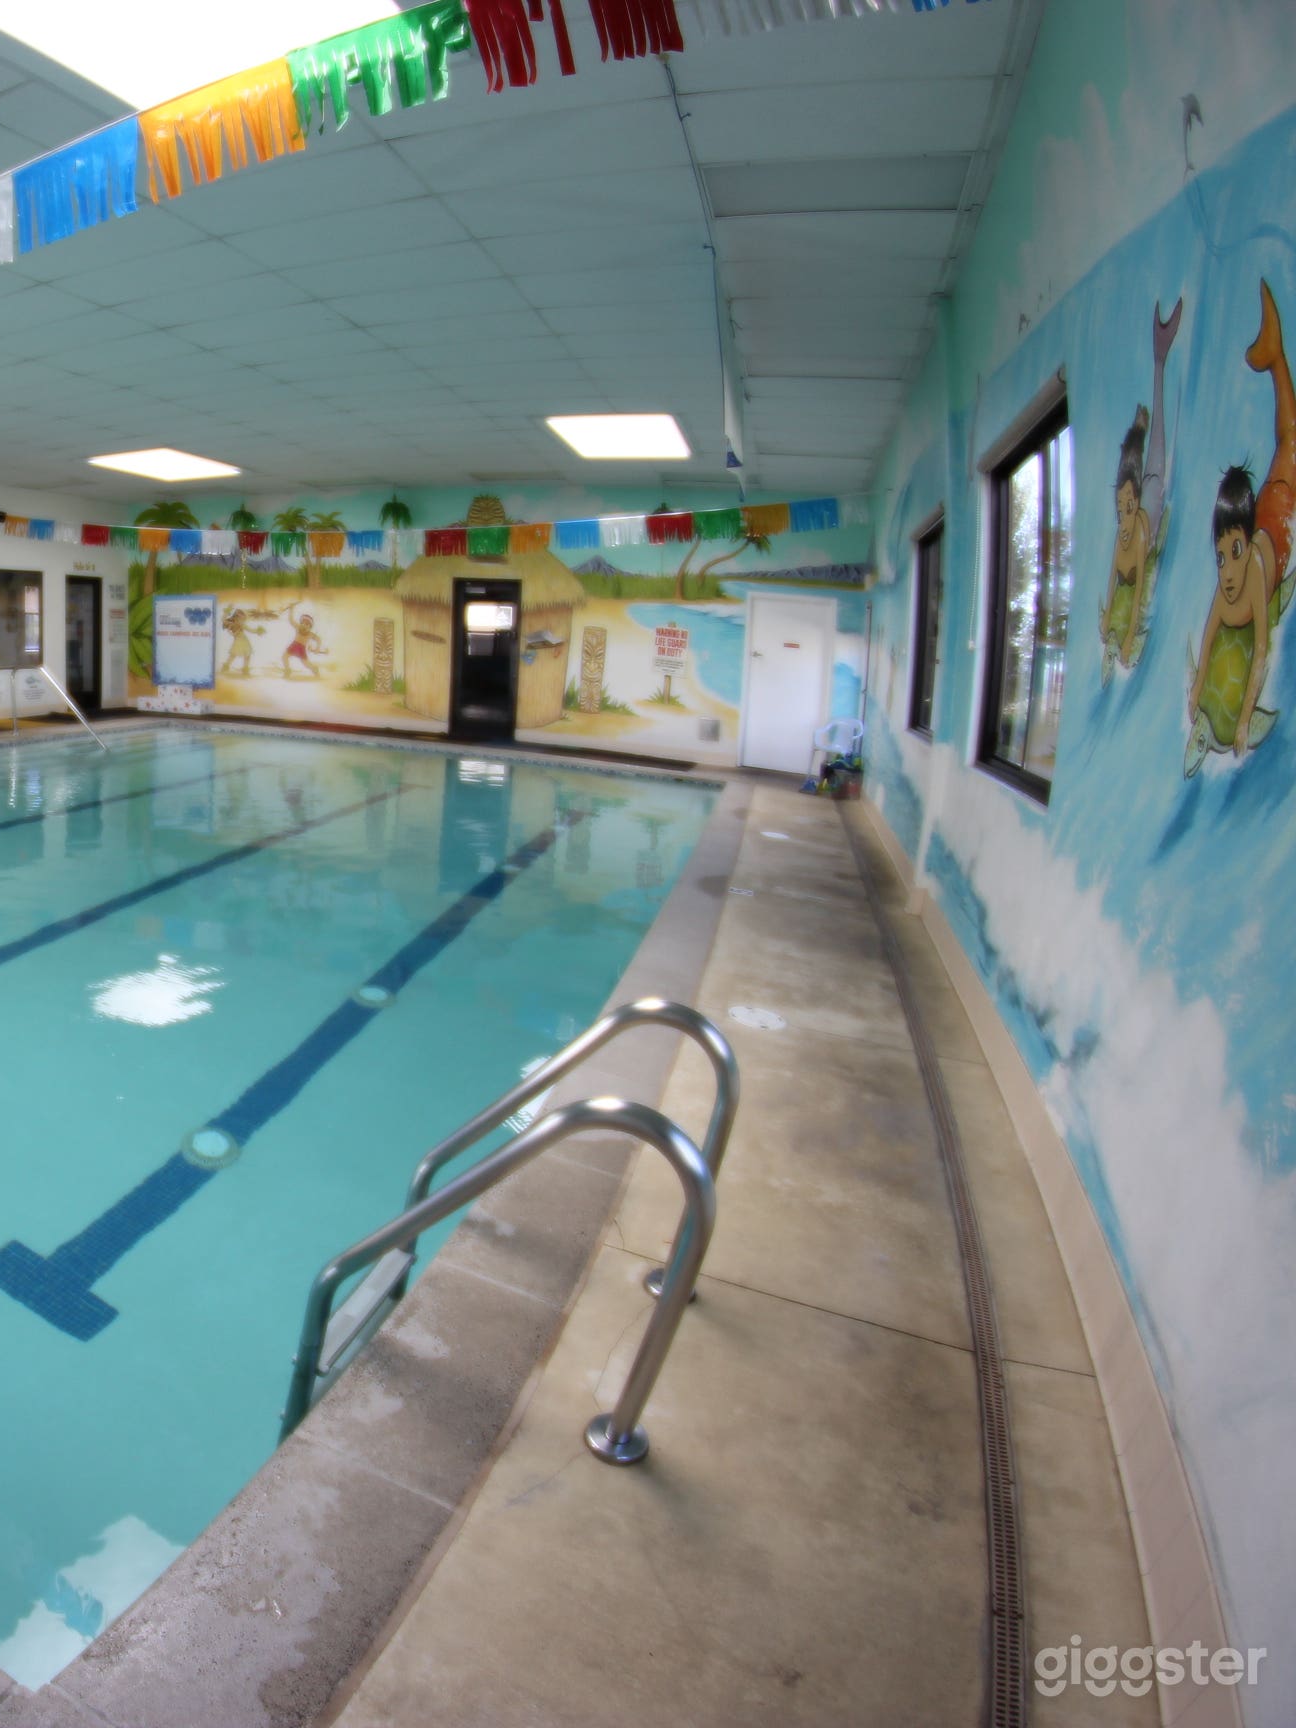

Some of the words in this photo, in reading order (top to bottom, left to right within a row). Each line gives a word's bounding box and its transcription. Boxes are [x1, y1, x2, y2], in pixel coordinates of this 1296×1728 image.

[656, 627, 680, 638] WARNING
[656, 637, 666, 646] LIFE
[667, 639, 687, 648] GUARD
[658, 646, 666, 656] ON
[666, 647, 683, 657] DUTY
